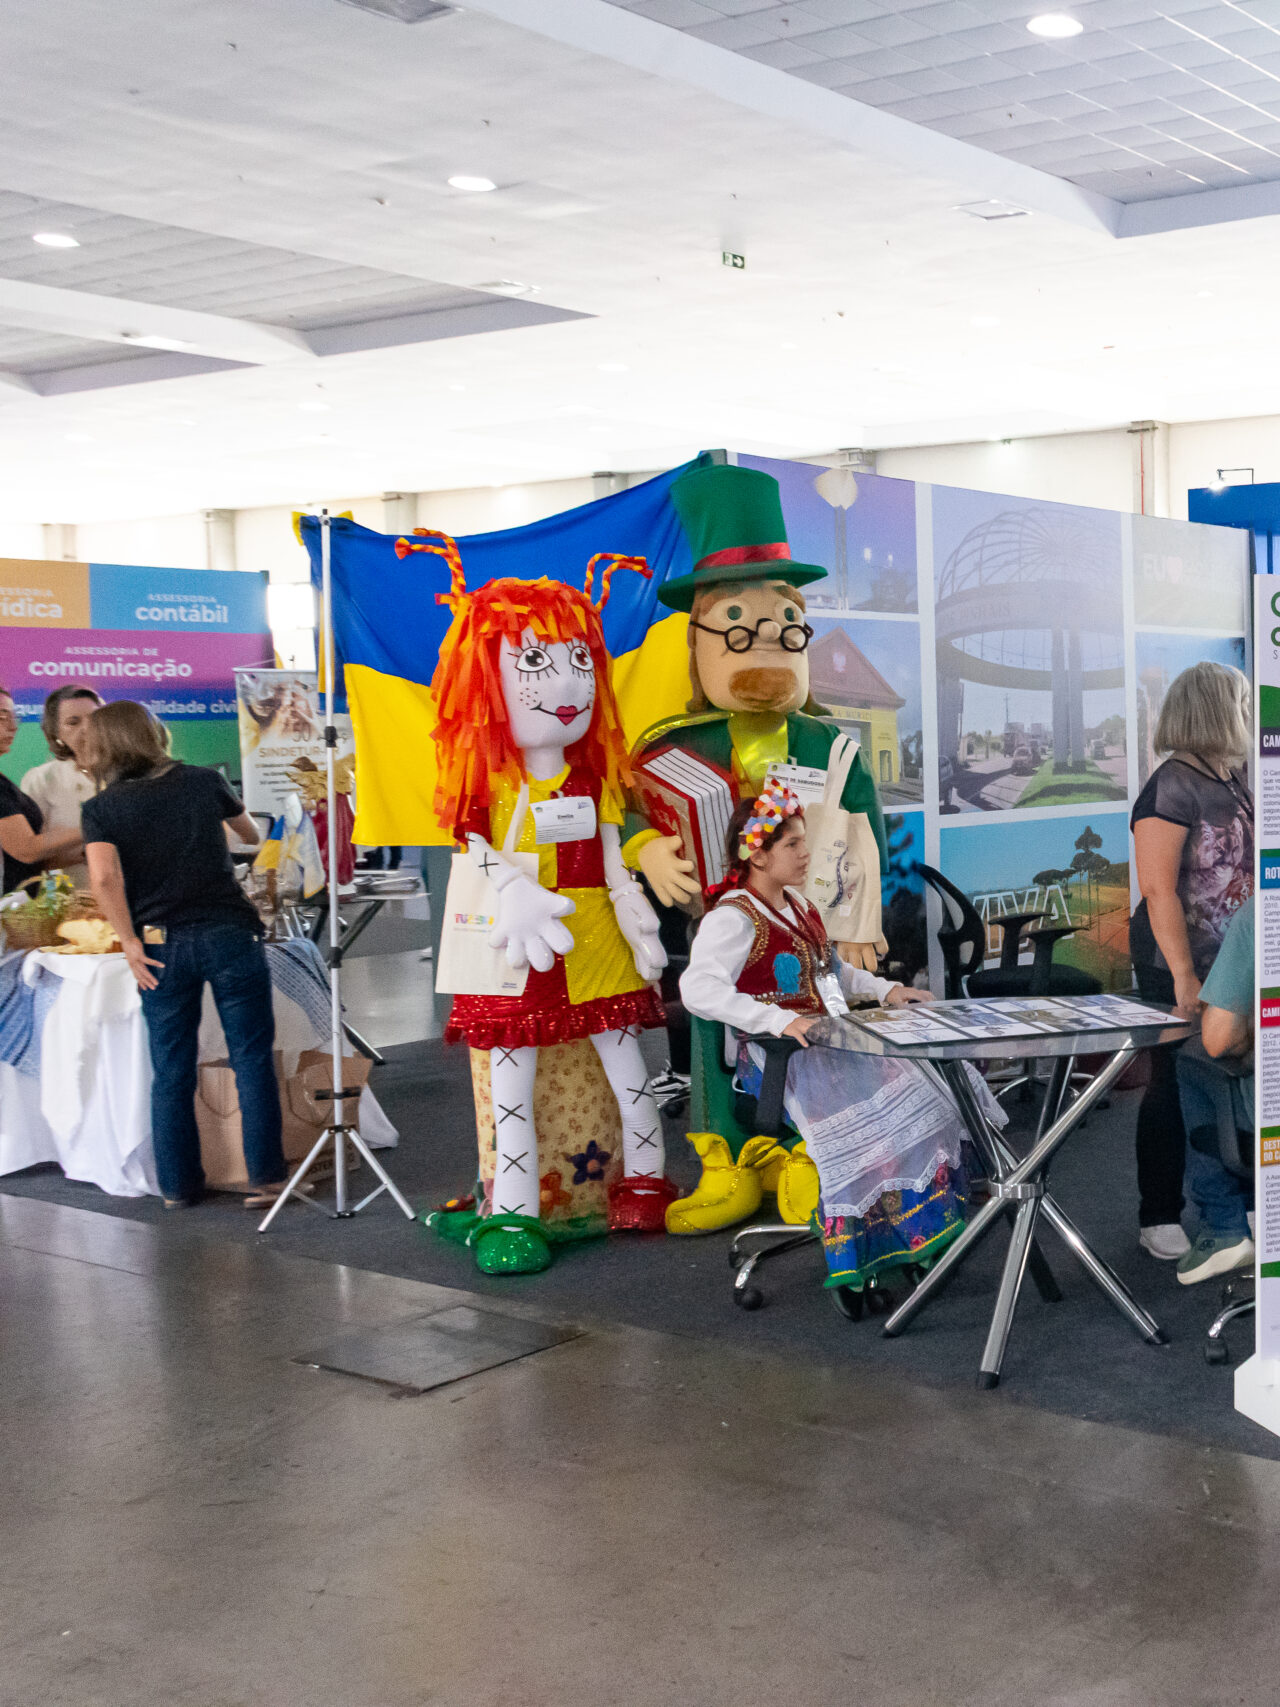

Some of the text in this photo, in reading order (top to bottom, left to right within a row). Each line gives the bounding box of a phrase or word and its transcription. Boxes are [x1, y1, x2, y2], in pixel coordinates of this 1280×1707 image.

[0, 597, 63, 618] ídica
[135, 604, 228, 623] contábil
[143, 648, 158, 656] DE
[28, 657, 192, 681] comunicação
[1264, 1152, 1272, 1161] DO
